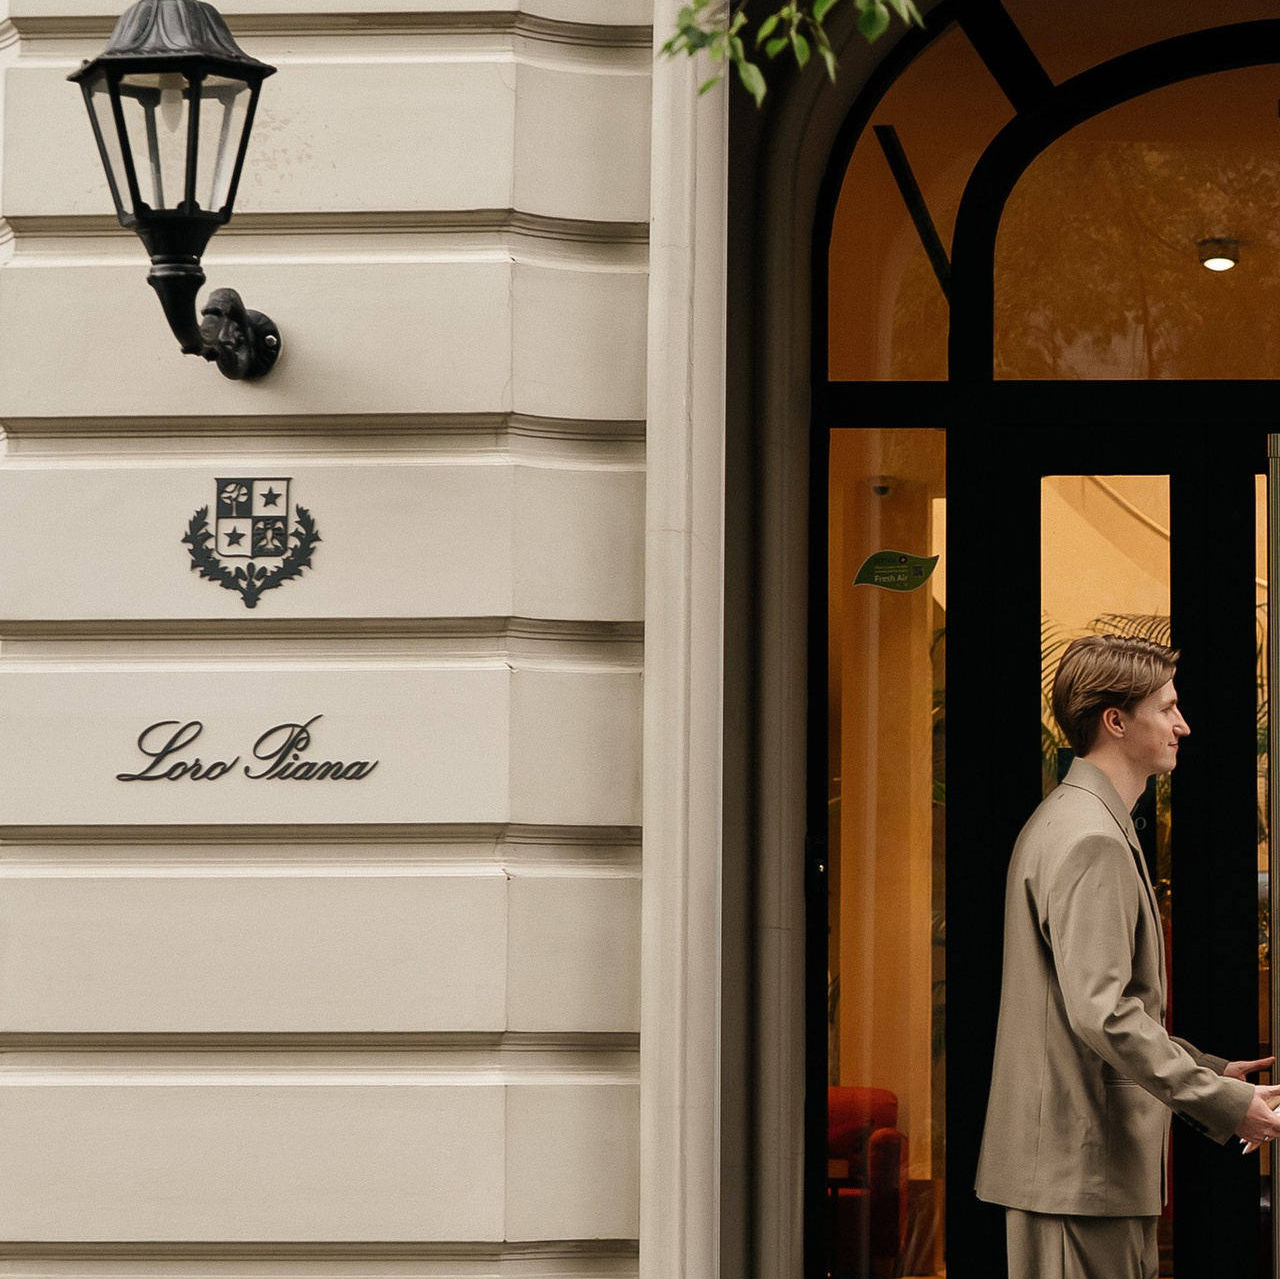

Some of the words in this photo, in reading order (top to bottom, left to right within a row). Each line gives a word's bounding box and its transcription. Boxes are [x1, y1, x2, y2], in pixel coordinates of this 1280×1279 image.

[874, 574, 896, 582] Fresh
[897, 574, 909, 582] Air
[115, 720, 240, 782] Loro
[243, 714, 380, 781] Piana
